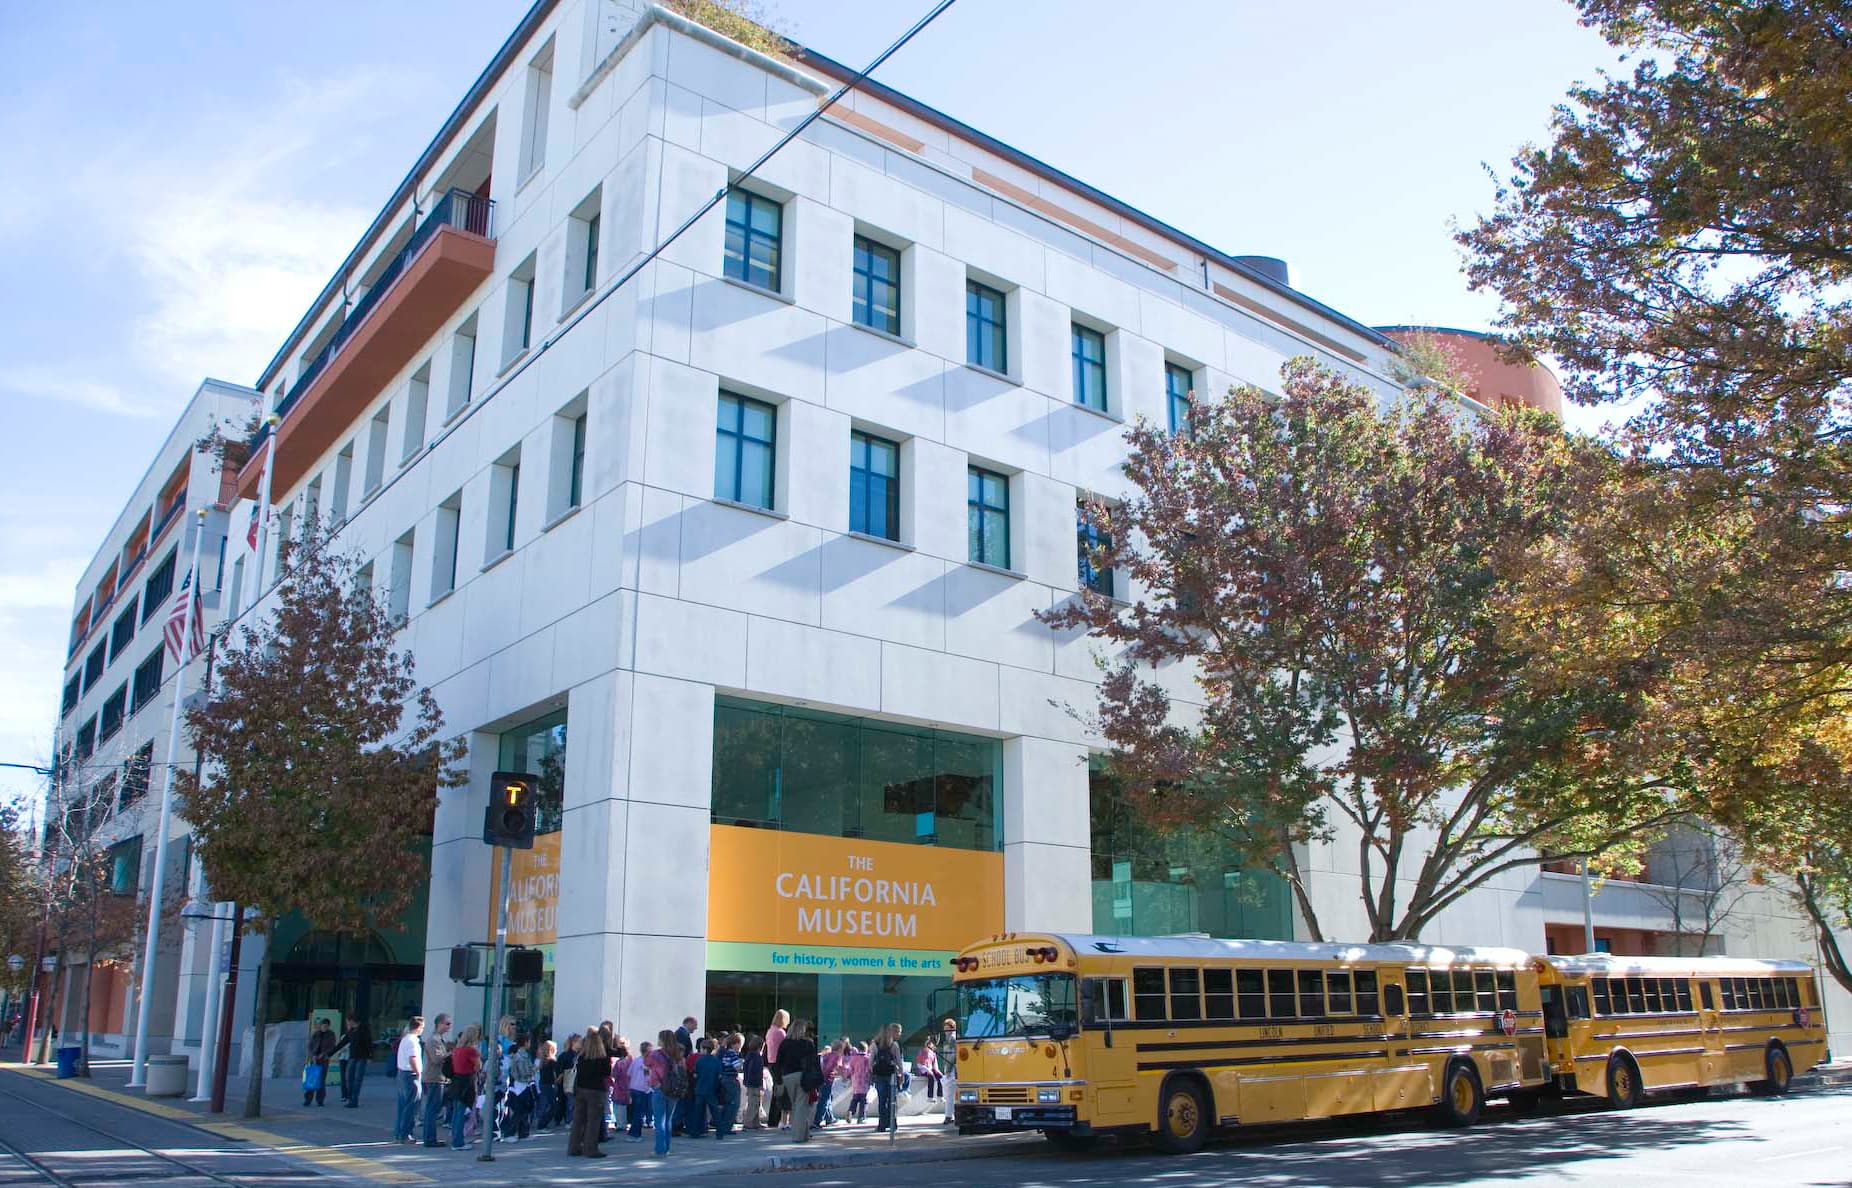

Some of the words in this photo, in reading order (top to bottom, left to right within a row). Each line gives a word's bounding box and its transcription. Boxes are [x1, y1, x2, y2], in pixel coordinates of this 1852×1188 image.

[507, 786, 522, 805] T
[533, 855, 548, 868] THE
[848, 855, 874, 871] THE
[510, 872, 560, 901] ALIFORN
[775, 872, 937, 906] CALIFORNIA
[507, 906, 558, 934] MUSEU
[797, 907, 918, 937] MUSEUM
[772, 951, 790, 964] for
[794, 952, 837, 969] history,
[841, 957, 884, 967] women
[887, 956, 896, 968] &
[900, 956, 918, 968] the
[921, 959, 941, 969] arts
[982, 950, 1011, 968] SCHOOL
[1014, 947, 1030, 964] BUS
[1052, 1065, 1058, 1079] 4
